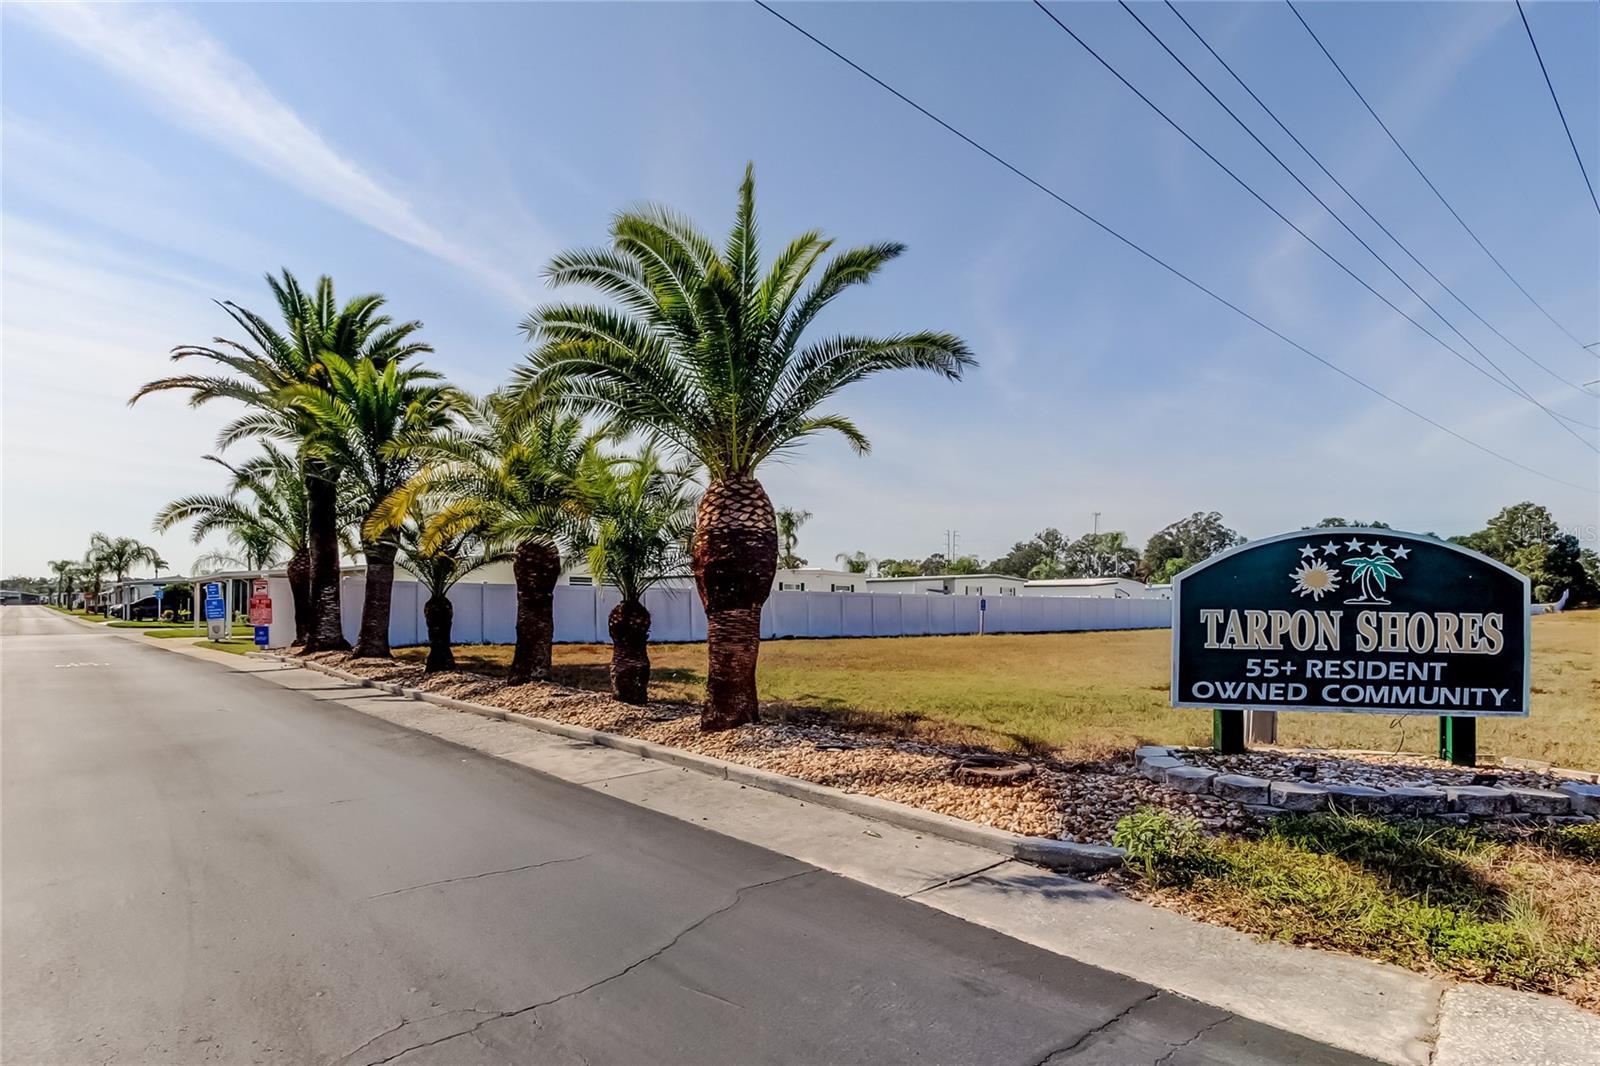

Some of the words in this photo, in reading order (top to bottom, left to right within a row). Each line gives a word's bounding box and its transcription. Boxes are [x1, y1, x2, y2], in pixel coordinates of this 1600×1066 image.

[1200, 609, 1344, 651] TARPON
[1356, 610, 1505, 656] SHORES
[1245, 658, 1297, 678] 55+
[1306, 659, 1448, 681] RESIDENT
[1191, 681, 1308, 701] OWNED
[1321, 684, 1509, 707] COMMUNITY
